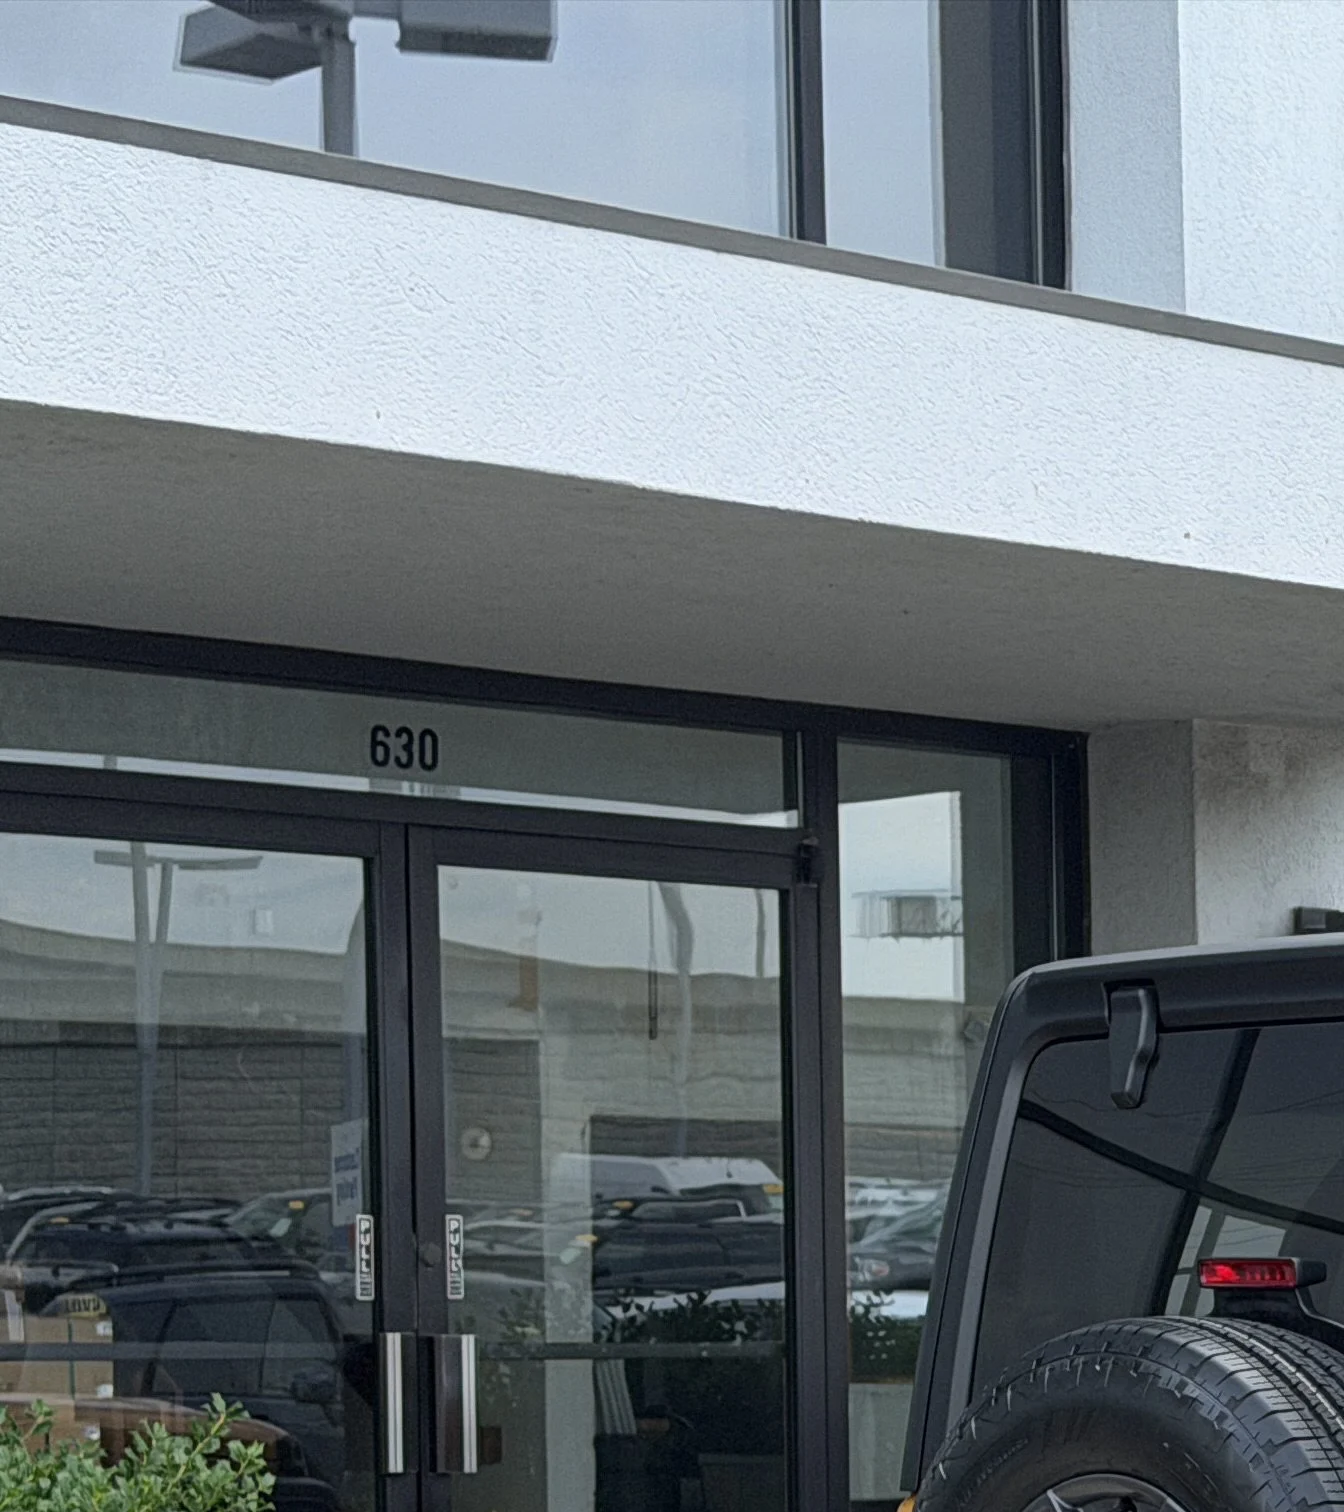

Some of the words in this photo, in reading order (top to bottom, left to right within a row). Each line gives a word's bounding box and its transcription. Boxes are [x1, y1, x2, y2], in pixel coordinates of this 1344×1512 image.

[370, 724, 440, 772] 630
[359, 1219, 371, 1272] PULL
[449, 1219, 460, 1272] PULL
